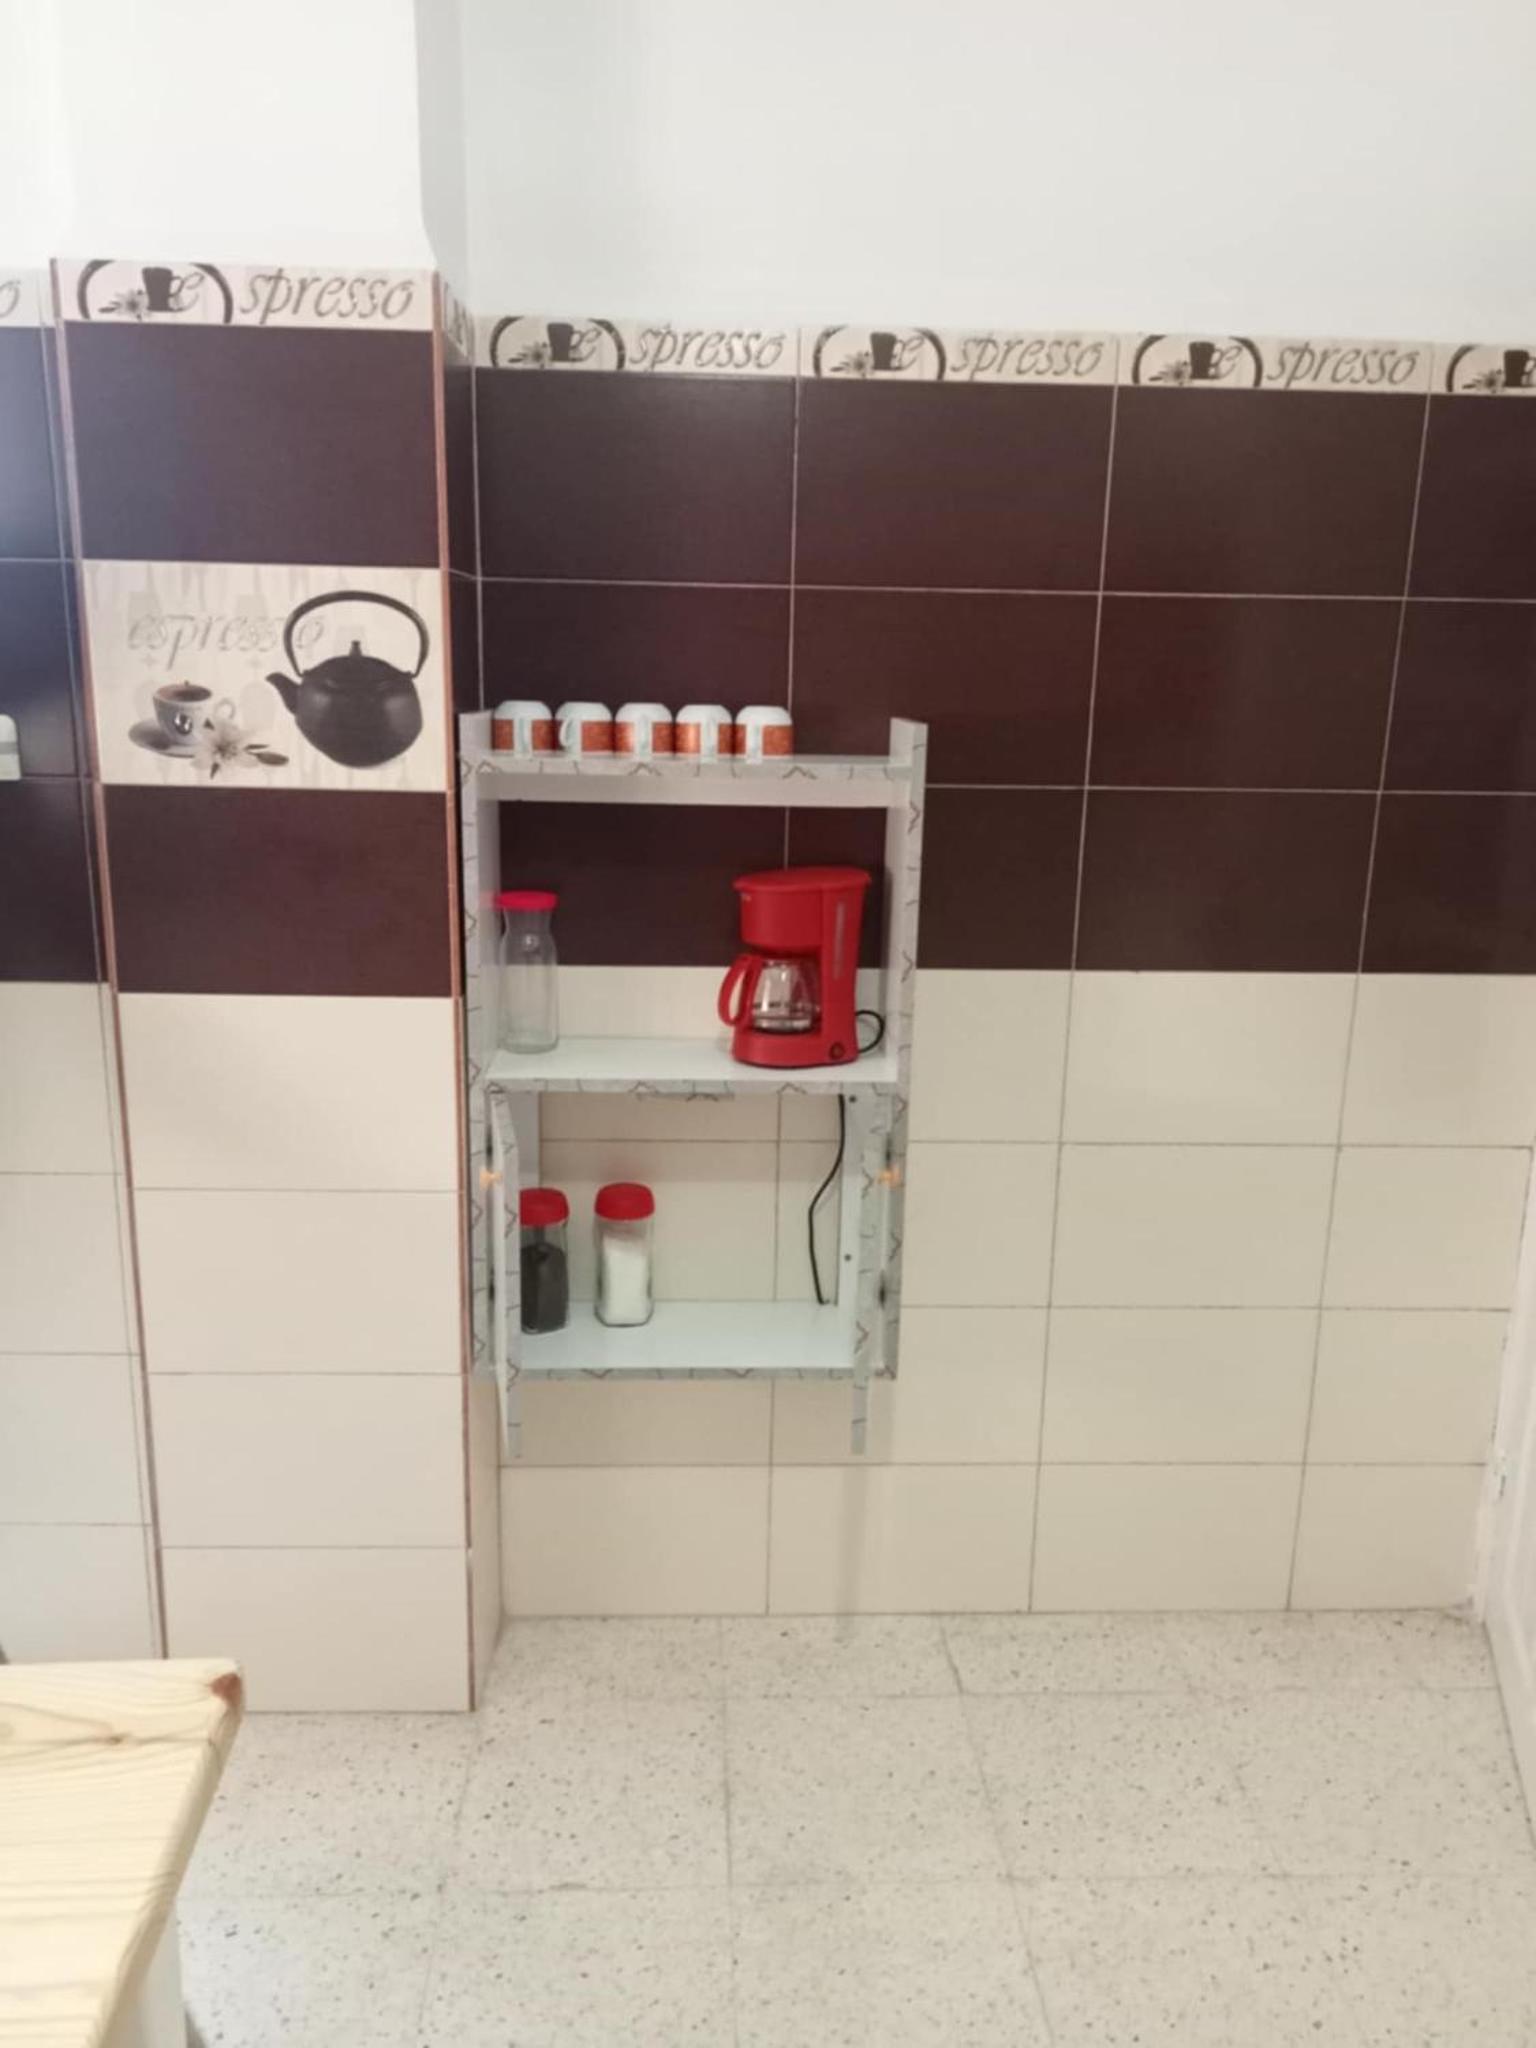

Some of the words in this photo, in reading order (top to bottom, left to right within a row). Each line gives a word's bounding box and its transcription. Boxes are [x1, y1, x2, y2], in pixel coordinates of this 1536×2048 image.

[239, 268, 414, 325] spresso
[629, 323, 786, 371] spresso
[950, 334, 1104, 382] spresso
[1266, 341, 1420, 388] spresso
[127, 613, 326, 671] espresso
